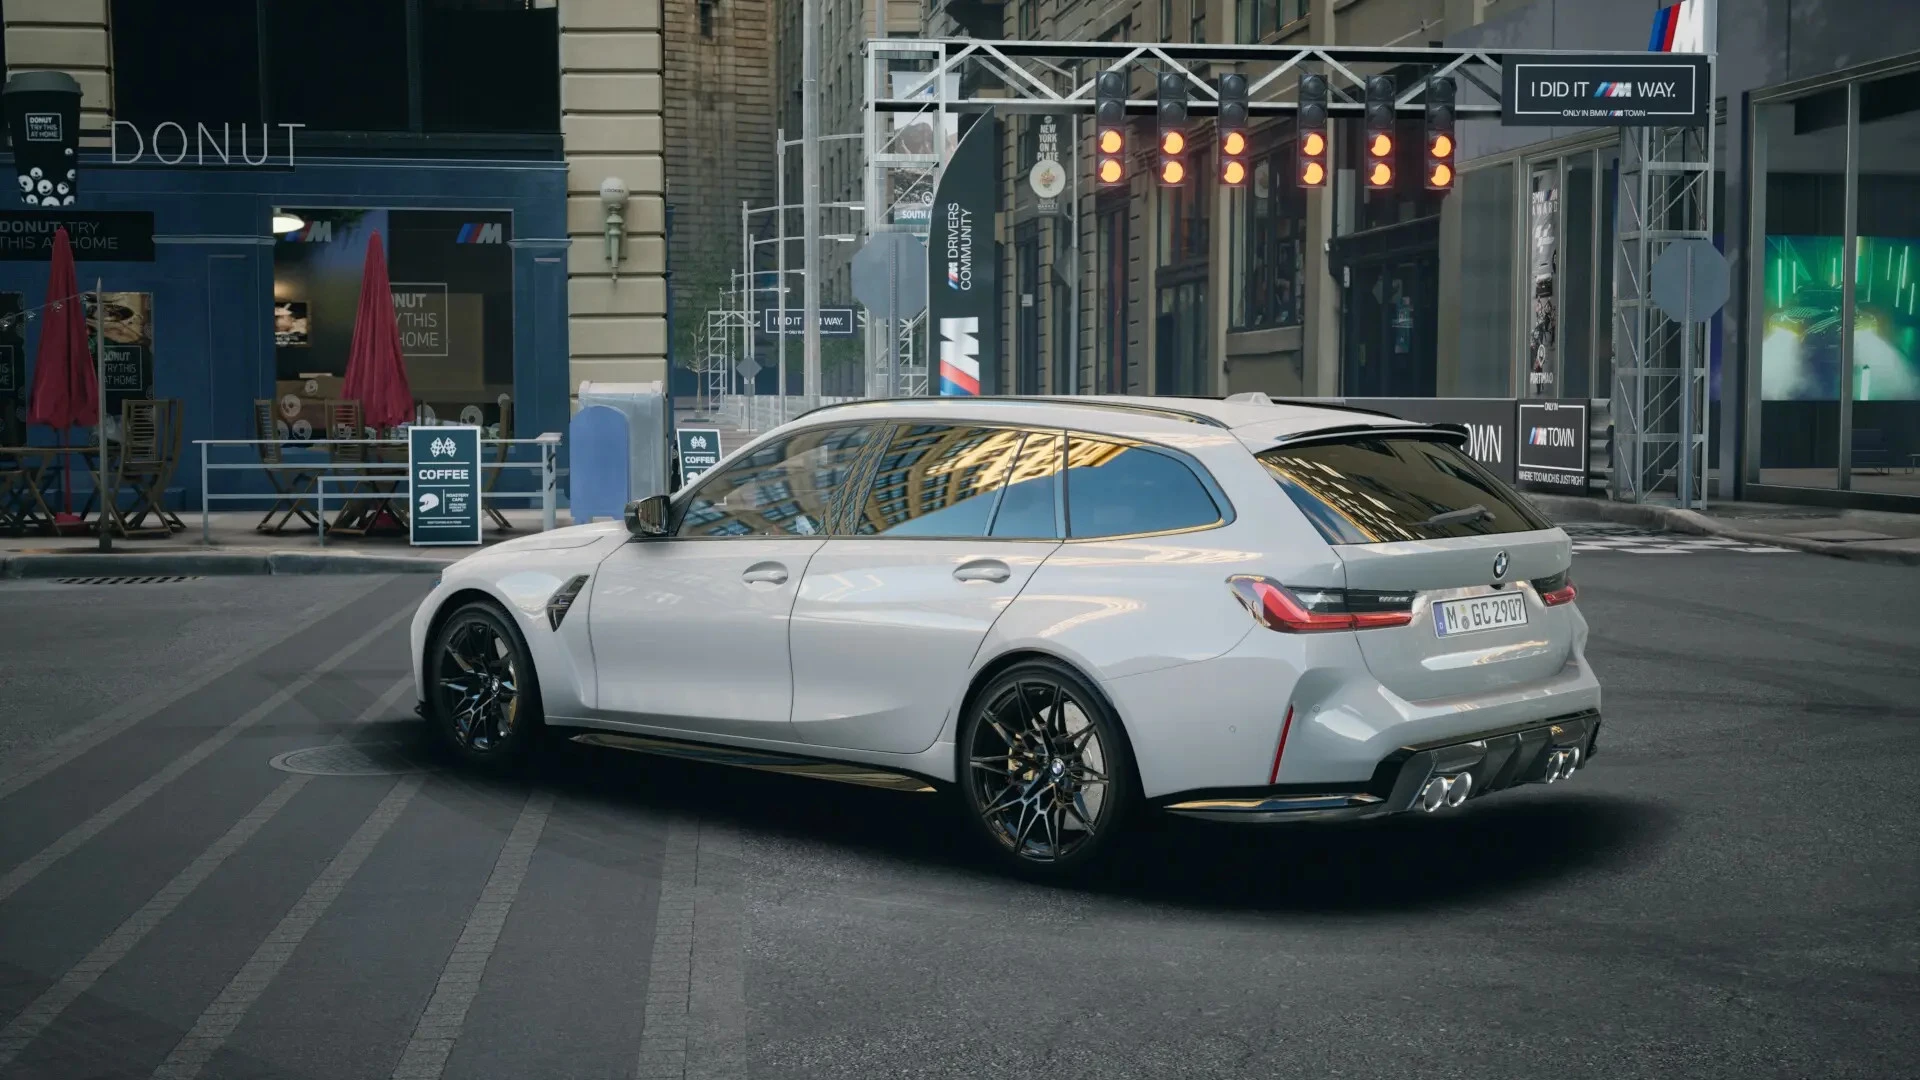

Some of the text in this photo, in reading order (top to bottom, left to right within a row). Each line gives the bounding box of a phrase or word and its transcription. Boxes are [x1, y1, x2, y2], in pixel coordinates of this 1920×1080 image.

[1531, 81, 1535, 97] I
[1540, 81, 1569, 97] DID
[1574, 81, 1589, 97] IT
[1637, 81, 1676, 98] WAY.
[1562, 109, 1581, 117] ONLY
[1624, 109, 1646, 117] TOWN
[29, 116, 52, 124] DONUT
[1040, 124, 1056, 133] NEW
[111, 121, 306, 167] DONUT
[1038, 134, 1057, 142] YORK
[1040, 142, 1056, 152] ON A
[1036, 152, 1059, 161] PLATE
[902, 210, 926, 220] SOUTH
[0, 220, 101, 234] DONUT TRY
[948, 202, 960, 258] DRIVERS
[0, 236, 36, 249] THIS
[960, 208, 972, 290] COMMUNITY
[391, 292, 426, 308] NUT
[404, 312, 438, 328] THIS
[794, 316, 802, 326] IT
[824, 316, 844, 326] WAY.
[120, 362, 137, 373] THIS
[114, 375, 138, 385] HOME
[1461, 422, 1502, 463] OWN
[1548, 427, 1574, 448] TOWN
[418, 469, 469, 480] COFFEE
[1518, 470, 1533, 480] WHERE
[1533, 472, 1543, 482] TOO
[1542, 472, 1555, 483] MUCH
[1560, 474, 1571, 485] JUST
[1571, 475, 1584, 486] RIGHT
[1446, 598, 1522, 630] M GC 2907
